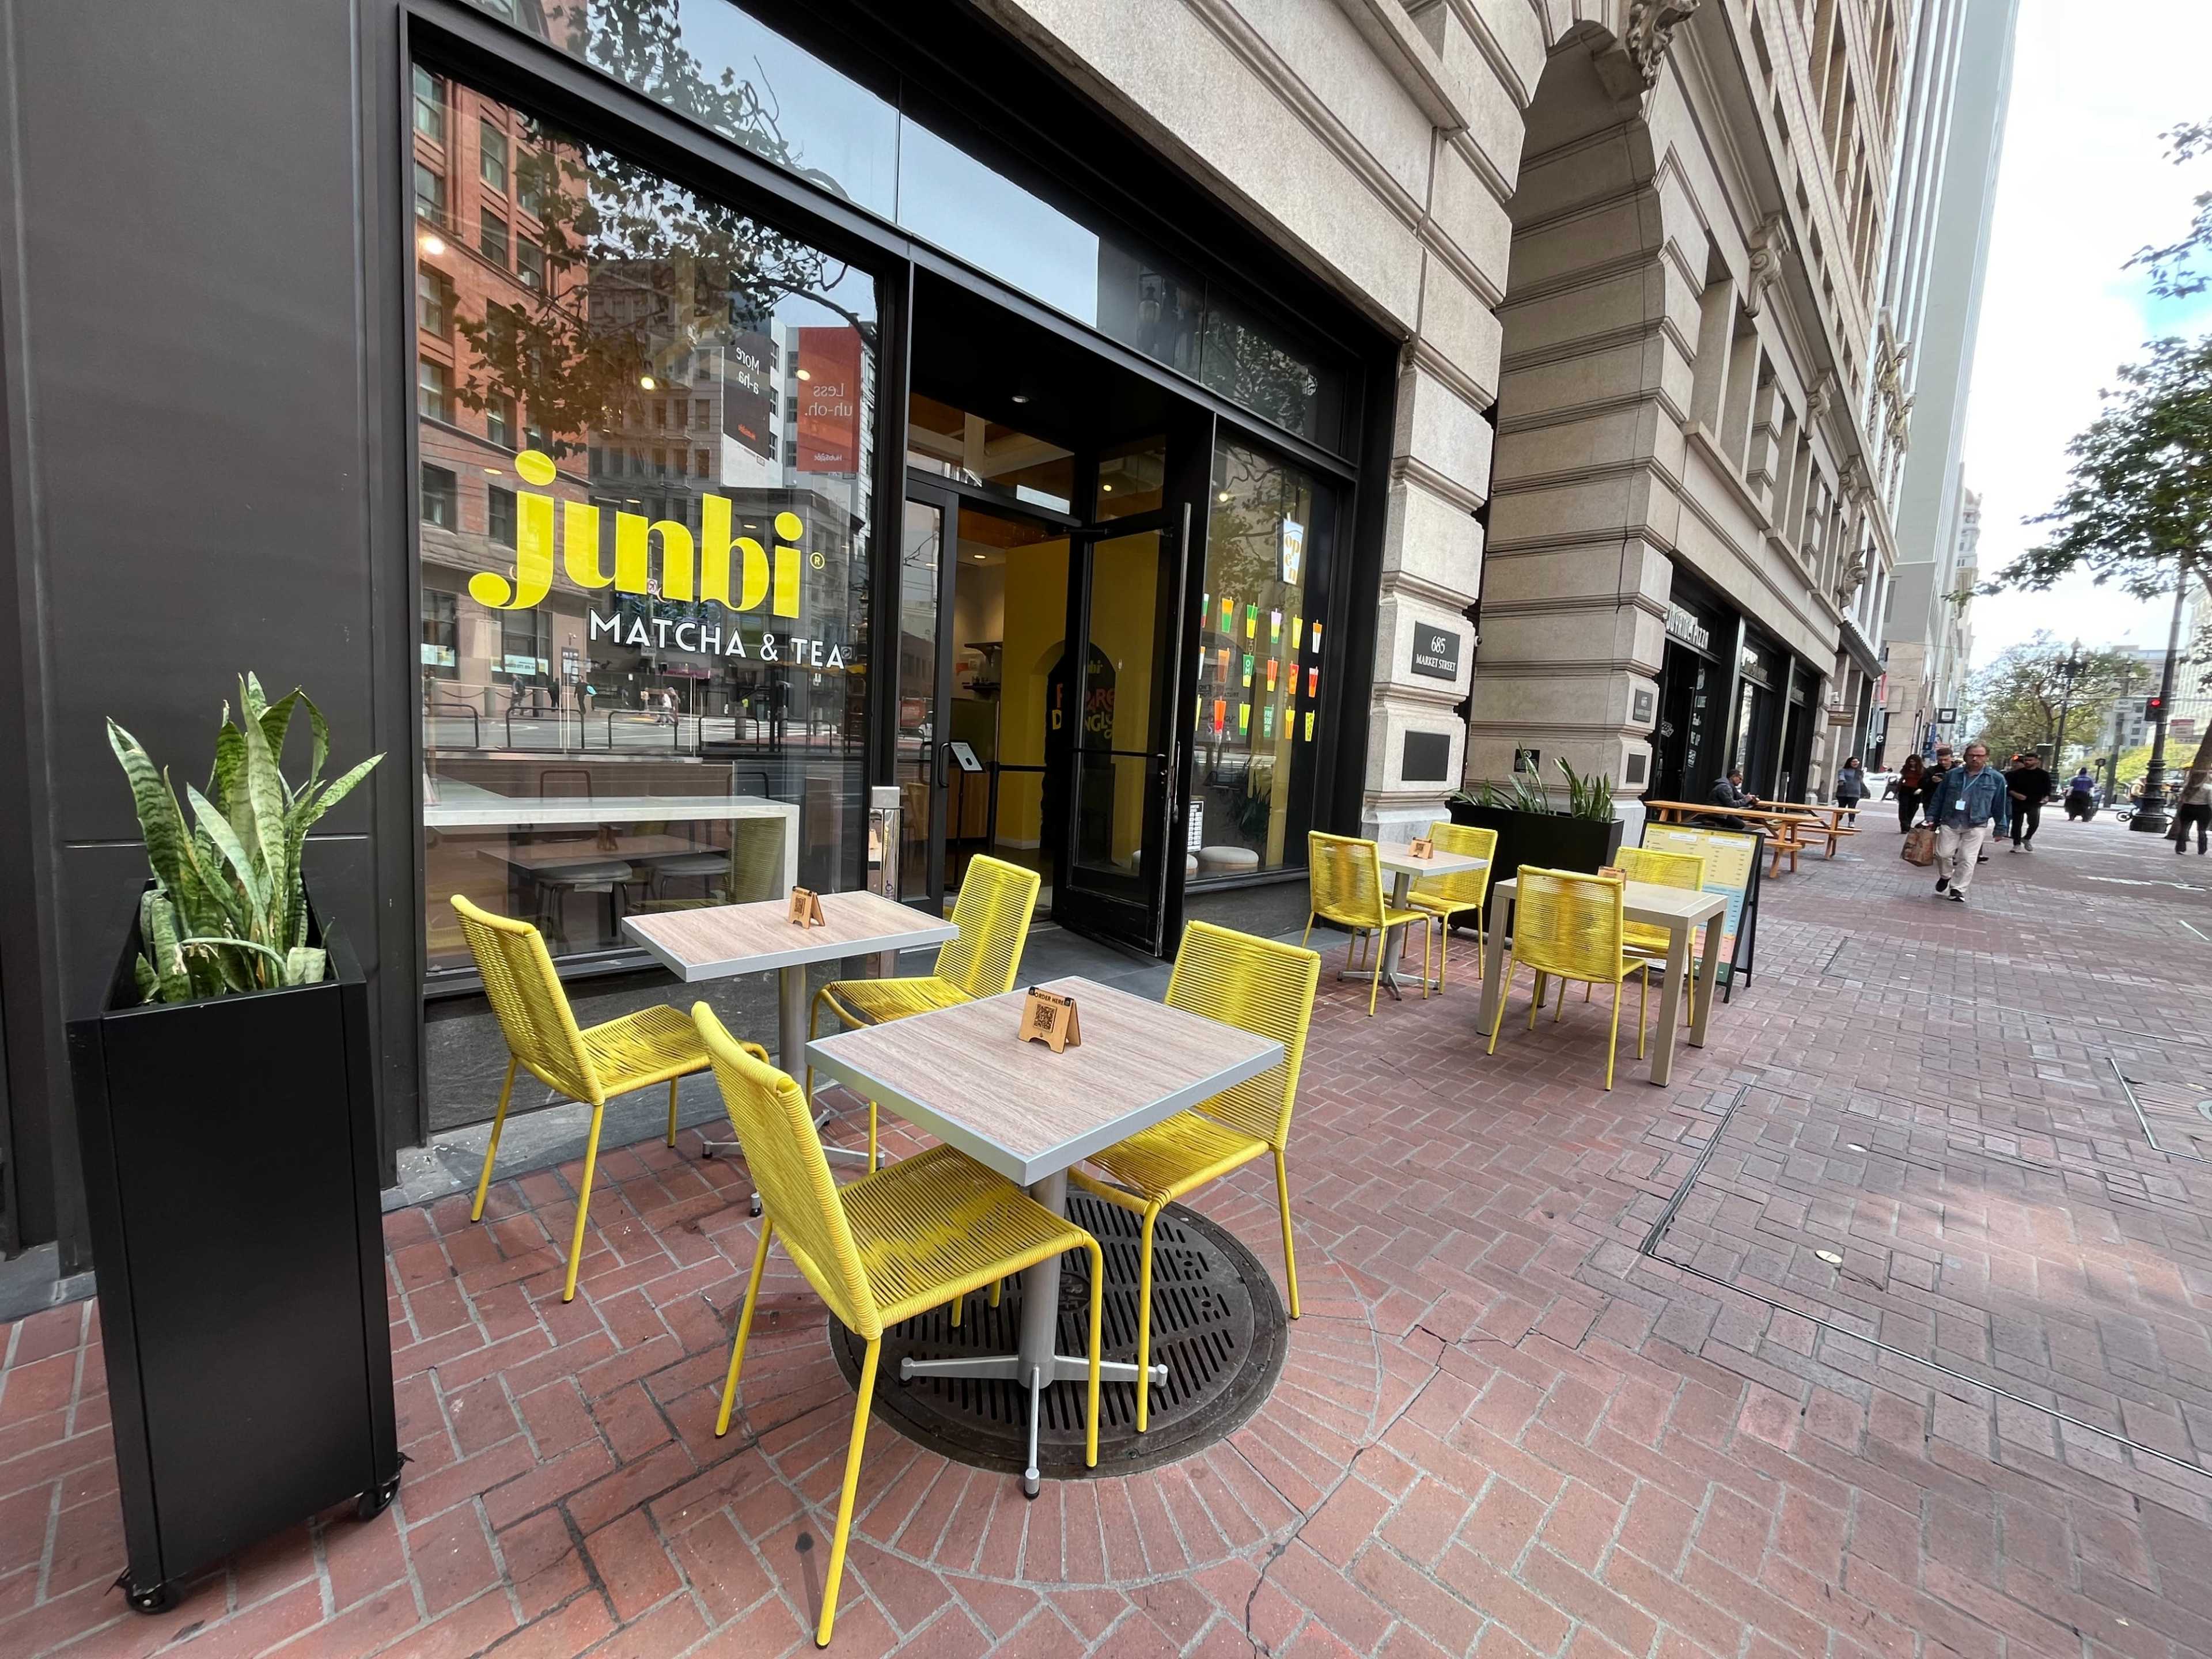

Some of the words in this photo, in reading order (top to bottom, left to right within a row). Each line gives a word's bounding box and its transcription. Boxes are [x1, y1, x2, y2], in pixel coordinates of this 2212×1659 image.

[589, 607, 747, 659] MATCHA
[759, 632, 779, 662] &
[790, 636, 845, 670] TEA
[1431, 635, 1446, 654] 685
[1415, 653, 1438, 668] MARKET
[1438, 659, 1456, 672] STREET
[1035, 992, 1051, 1001] ORDER
